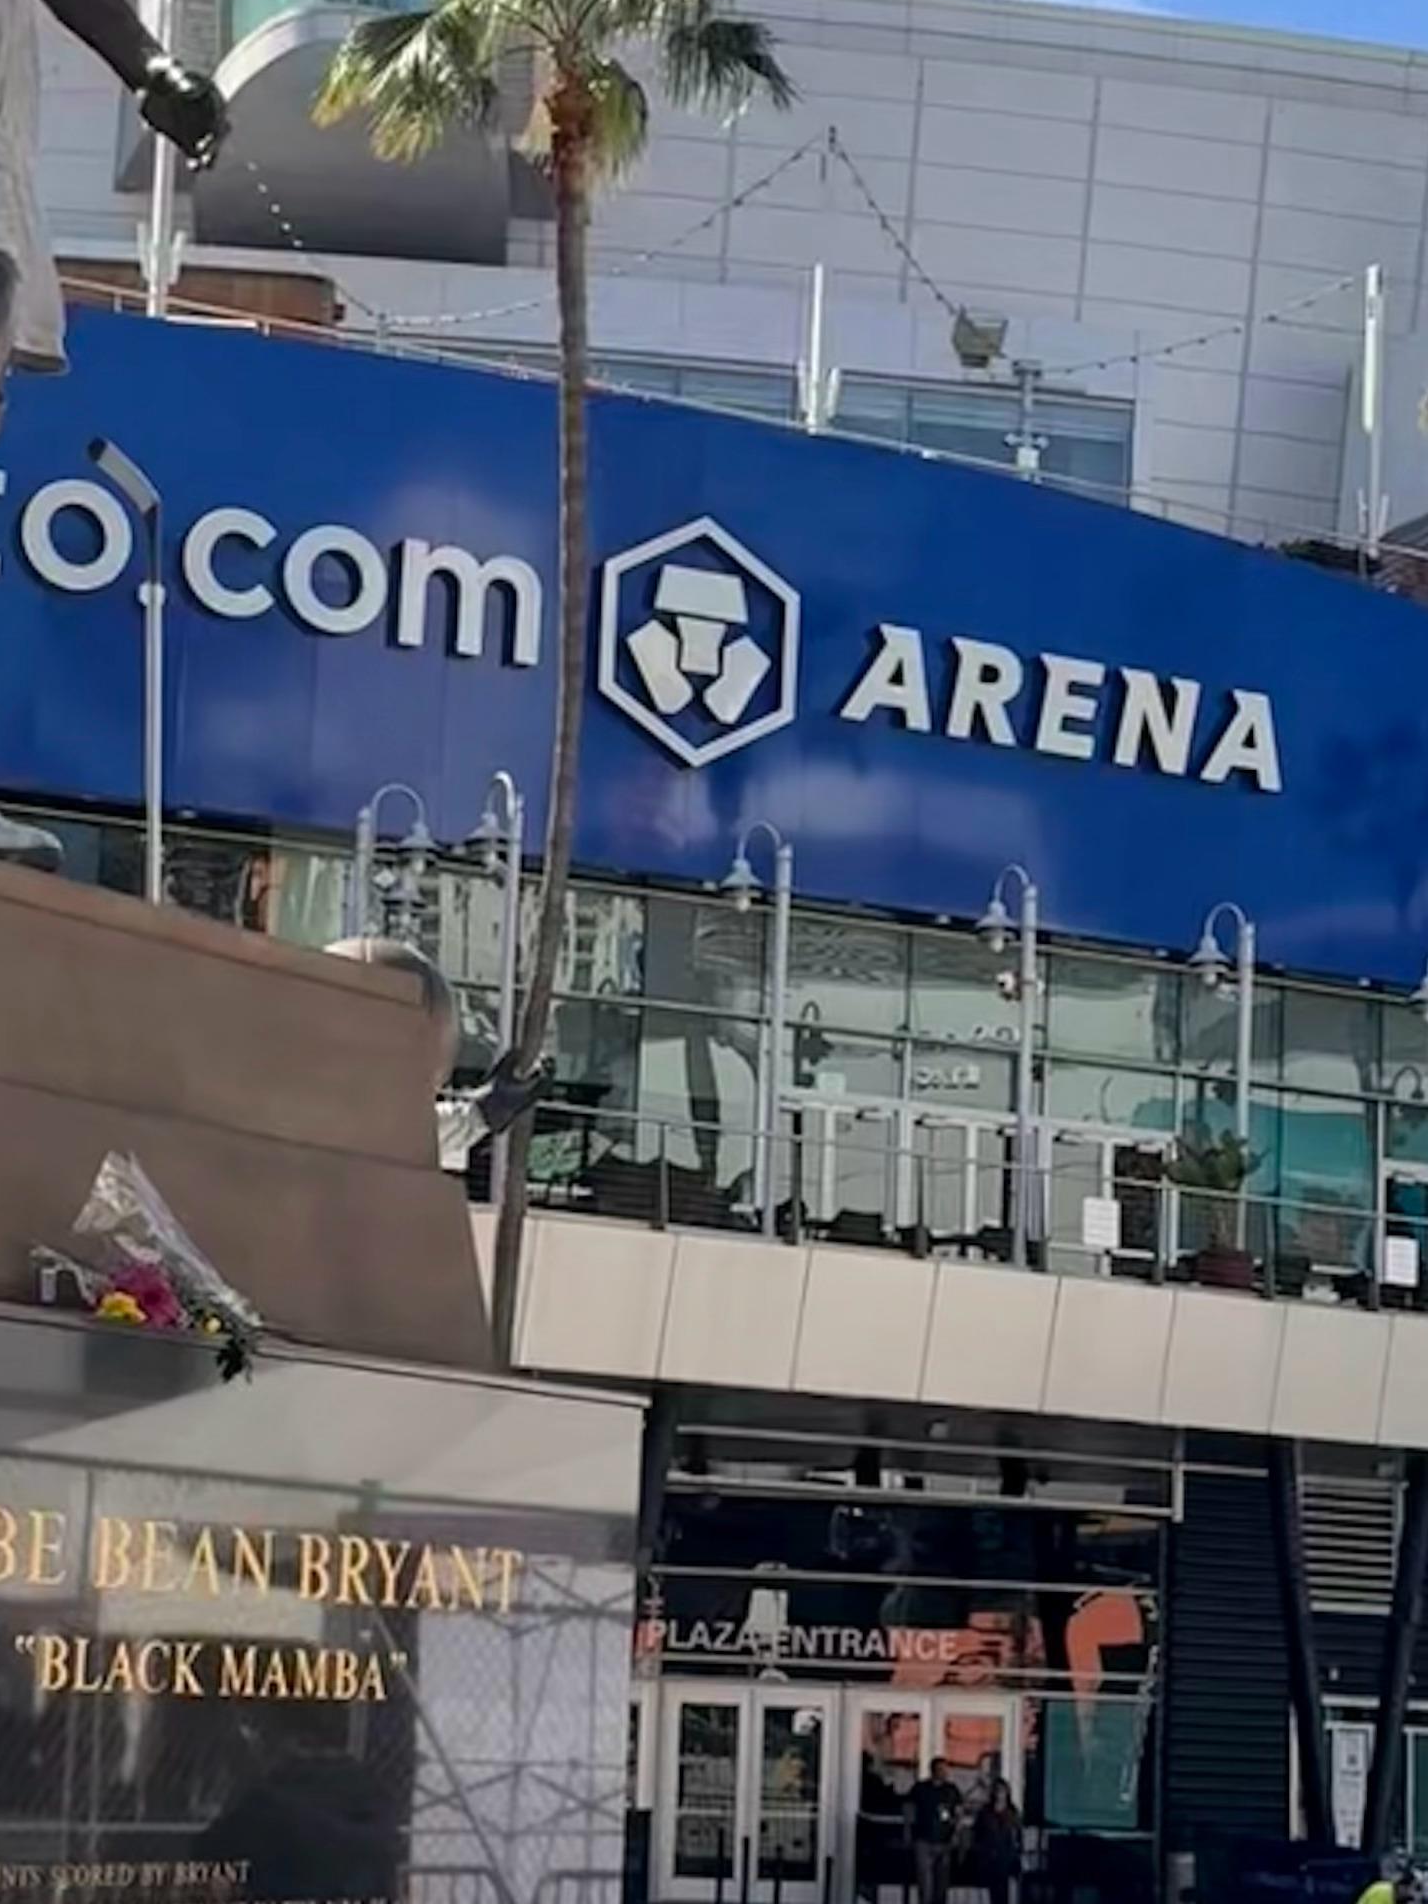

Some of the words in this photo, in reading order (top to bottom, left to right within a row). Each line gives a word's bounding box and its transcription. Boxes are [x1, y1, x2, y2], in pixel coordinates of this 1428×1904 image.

[841, 622, 1284, 793] ARENA
[94, 1516, 274, 1594] BEAN
[298, 1533, 524, 1614] BRYANT
[15, 1634, 205, 1698] “BLACK
[219, 1644, 409, 1702] MAMBA”
[650, 1618, 760, 1653] PLAZA
[776, 1625, 959, 1662] ENTRANCE
[49, 1861, 136, 1889] SCORED
[139, 1862, 169, 1887] BY
[172, 1859, 253, 1886] BRYANT
